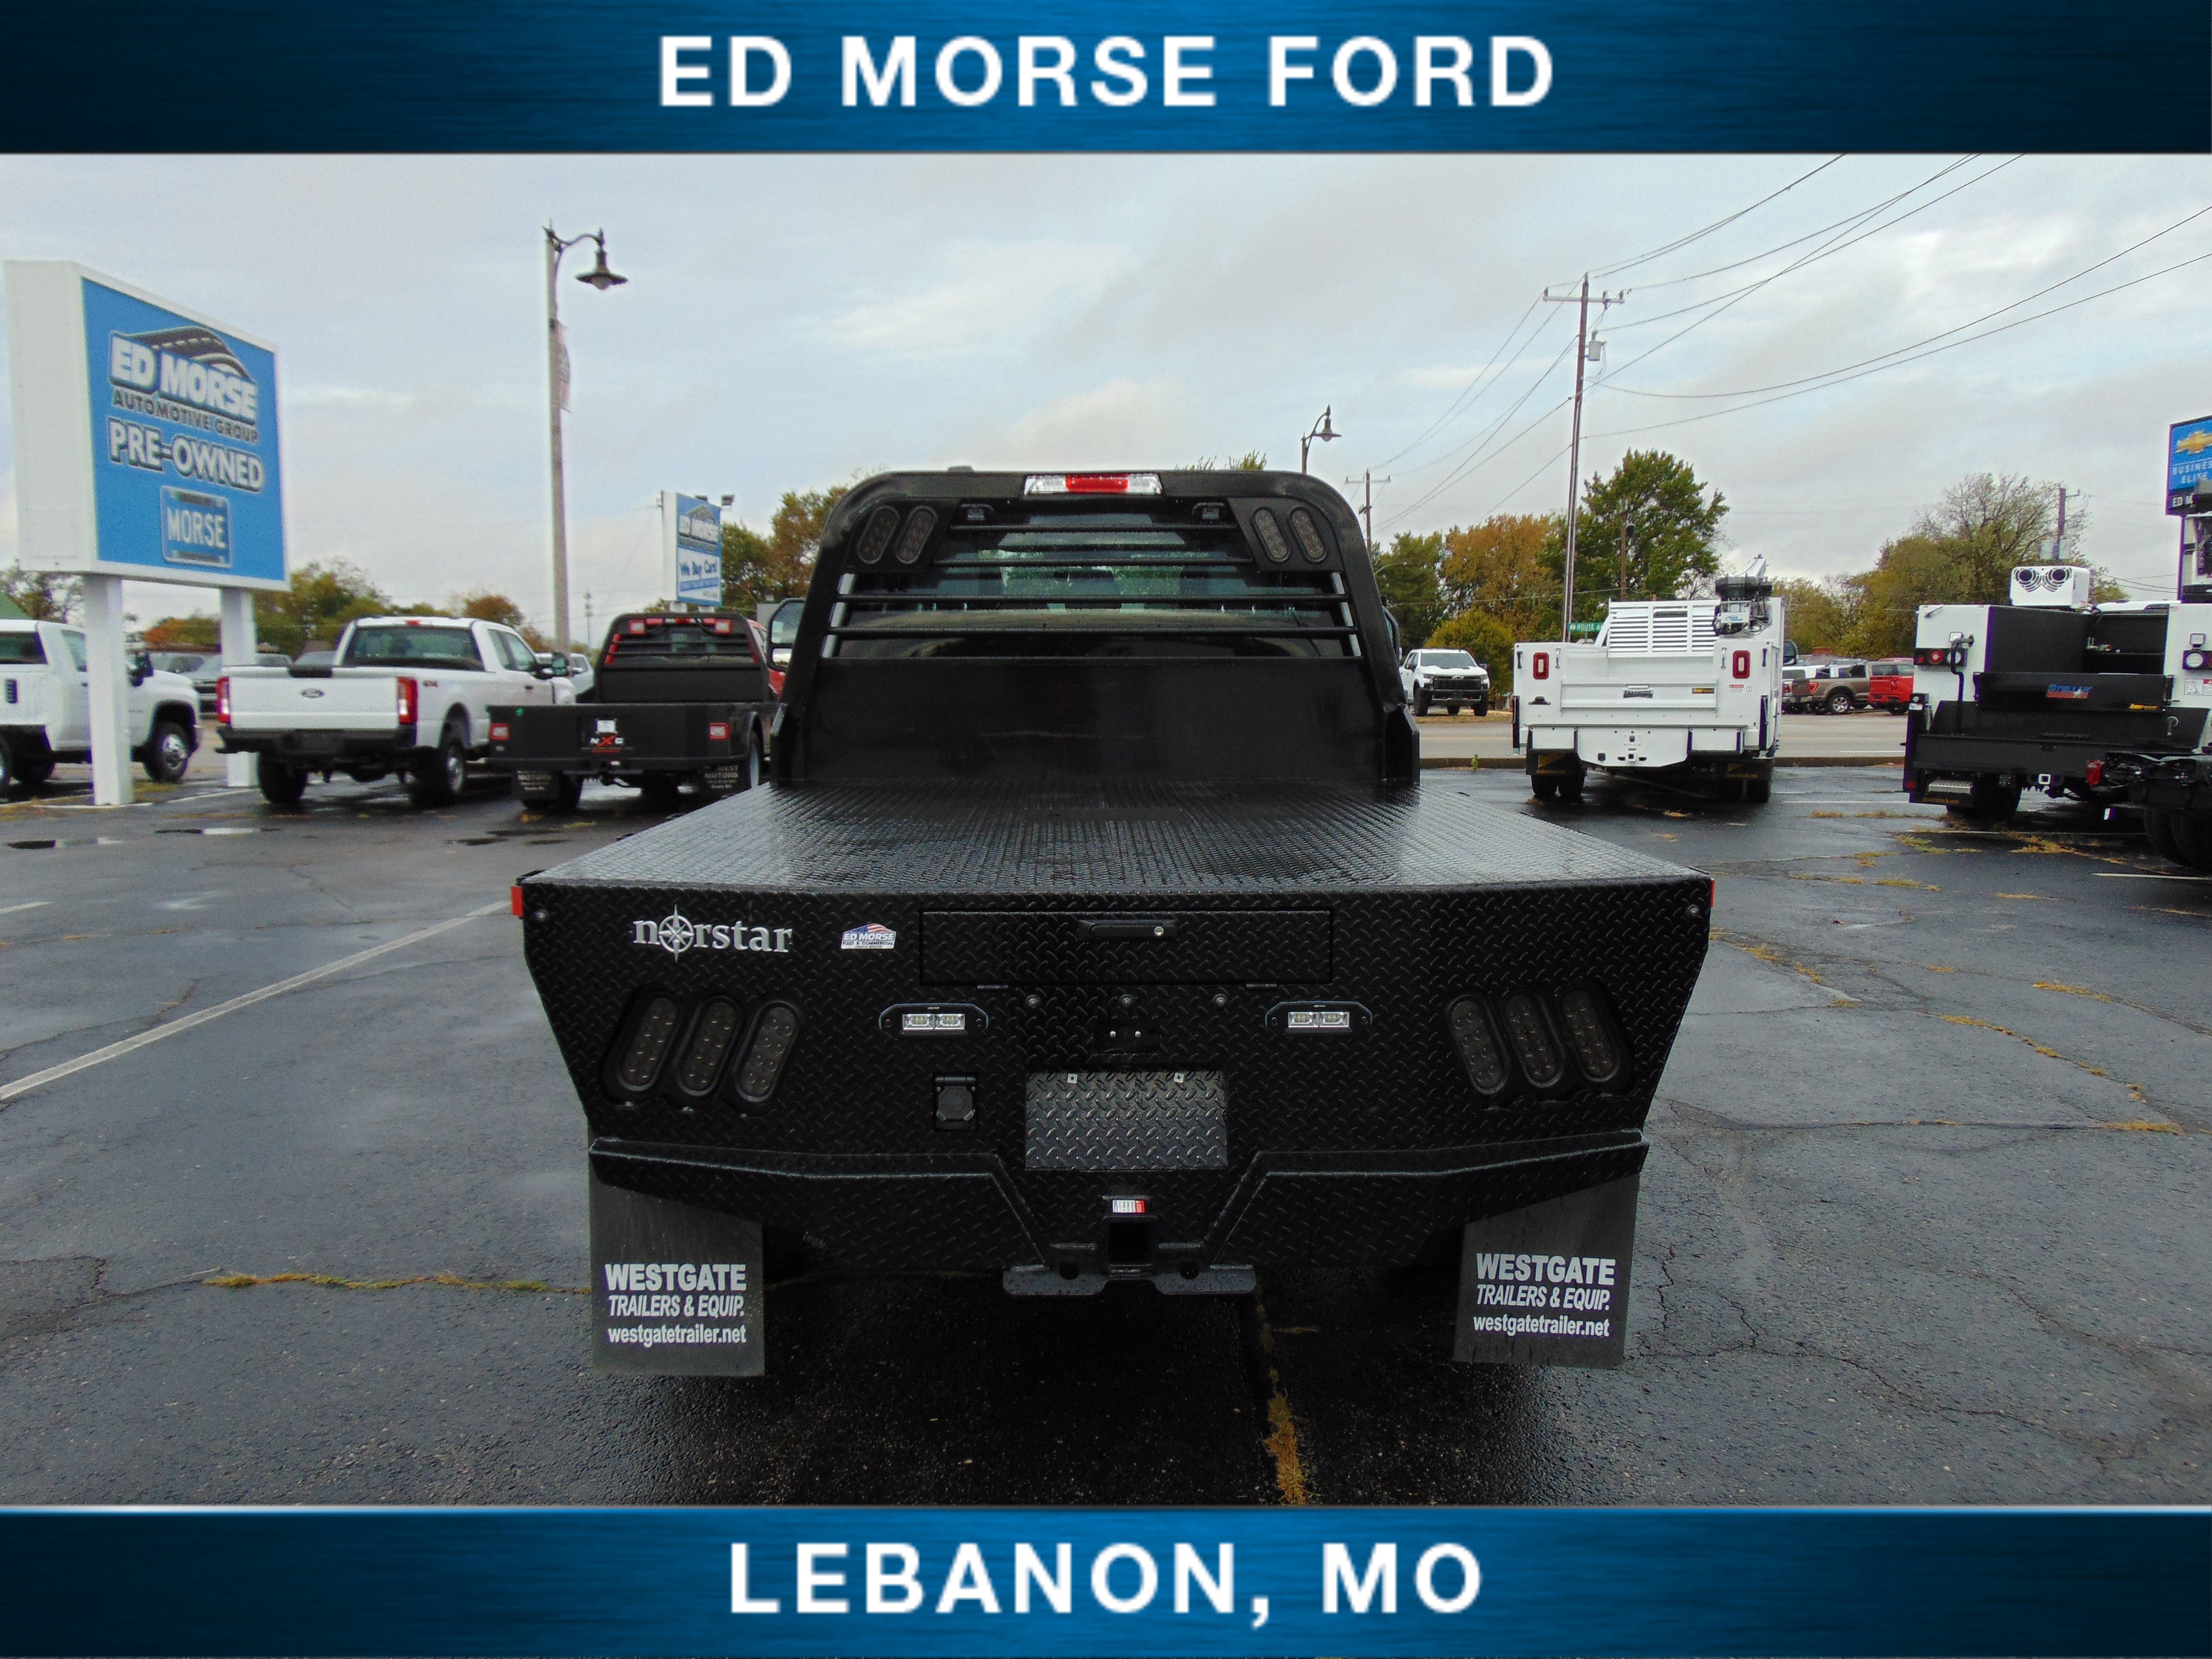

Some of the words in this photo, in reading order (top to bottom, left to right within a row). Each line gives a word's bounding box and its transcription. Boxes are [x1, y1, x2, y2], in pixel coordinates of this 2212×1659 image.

[111, 337, 156, 387] ED
[160, 352, 257, 420] MORSE
[112, 387, 210, 430] AUTOMOTIVE
[215, 418, 258, 444] GROUP
[108, 418, 264, 491] PRE-OWNED
[2172, 497, 2183, 507] ED
[167, 507, 226, 548] MORSE
[605, 1263, 747, 1291] WESTGATE
[1476, 1252, 1616, 1285] WESTGATE
[609, 1295, 681, 1317] TRAILERS
[684, 1295, 695, 1317] &
[698, 1295, 744, 1318] EQUIP.
[1477, 1284, 1547, 1307] TRAILERS
[1550, 1287, 1560, 1308] &
[1563, 1288, 1610, 1311] EQUIP.
[608, 1324, 747, 1348] westgatetrailer.net
[1473, 1313, 1610, 1336] westgatetrailer.net
